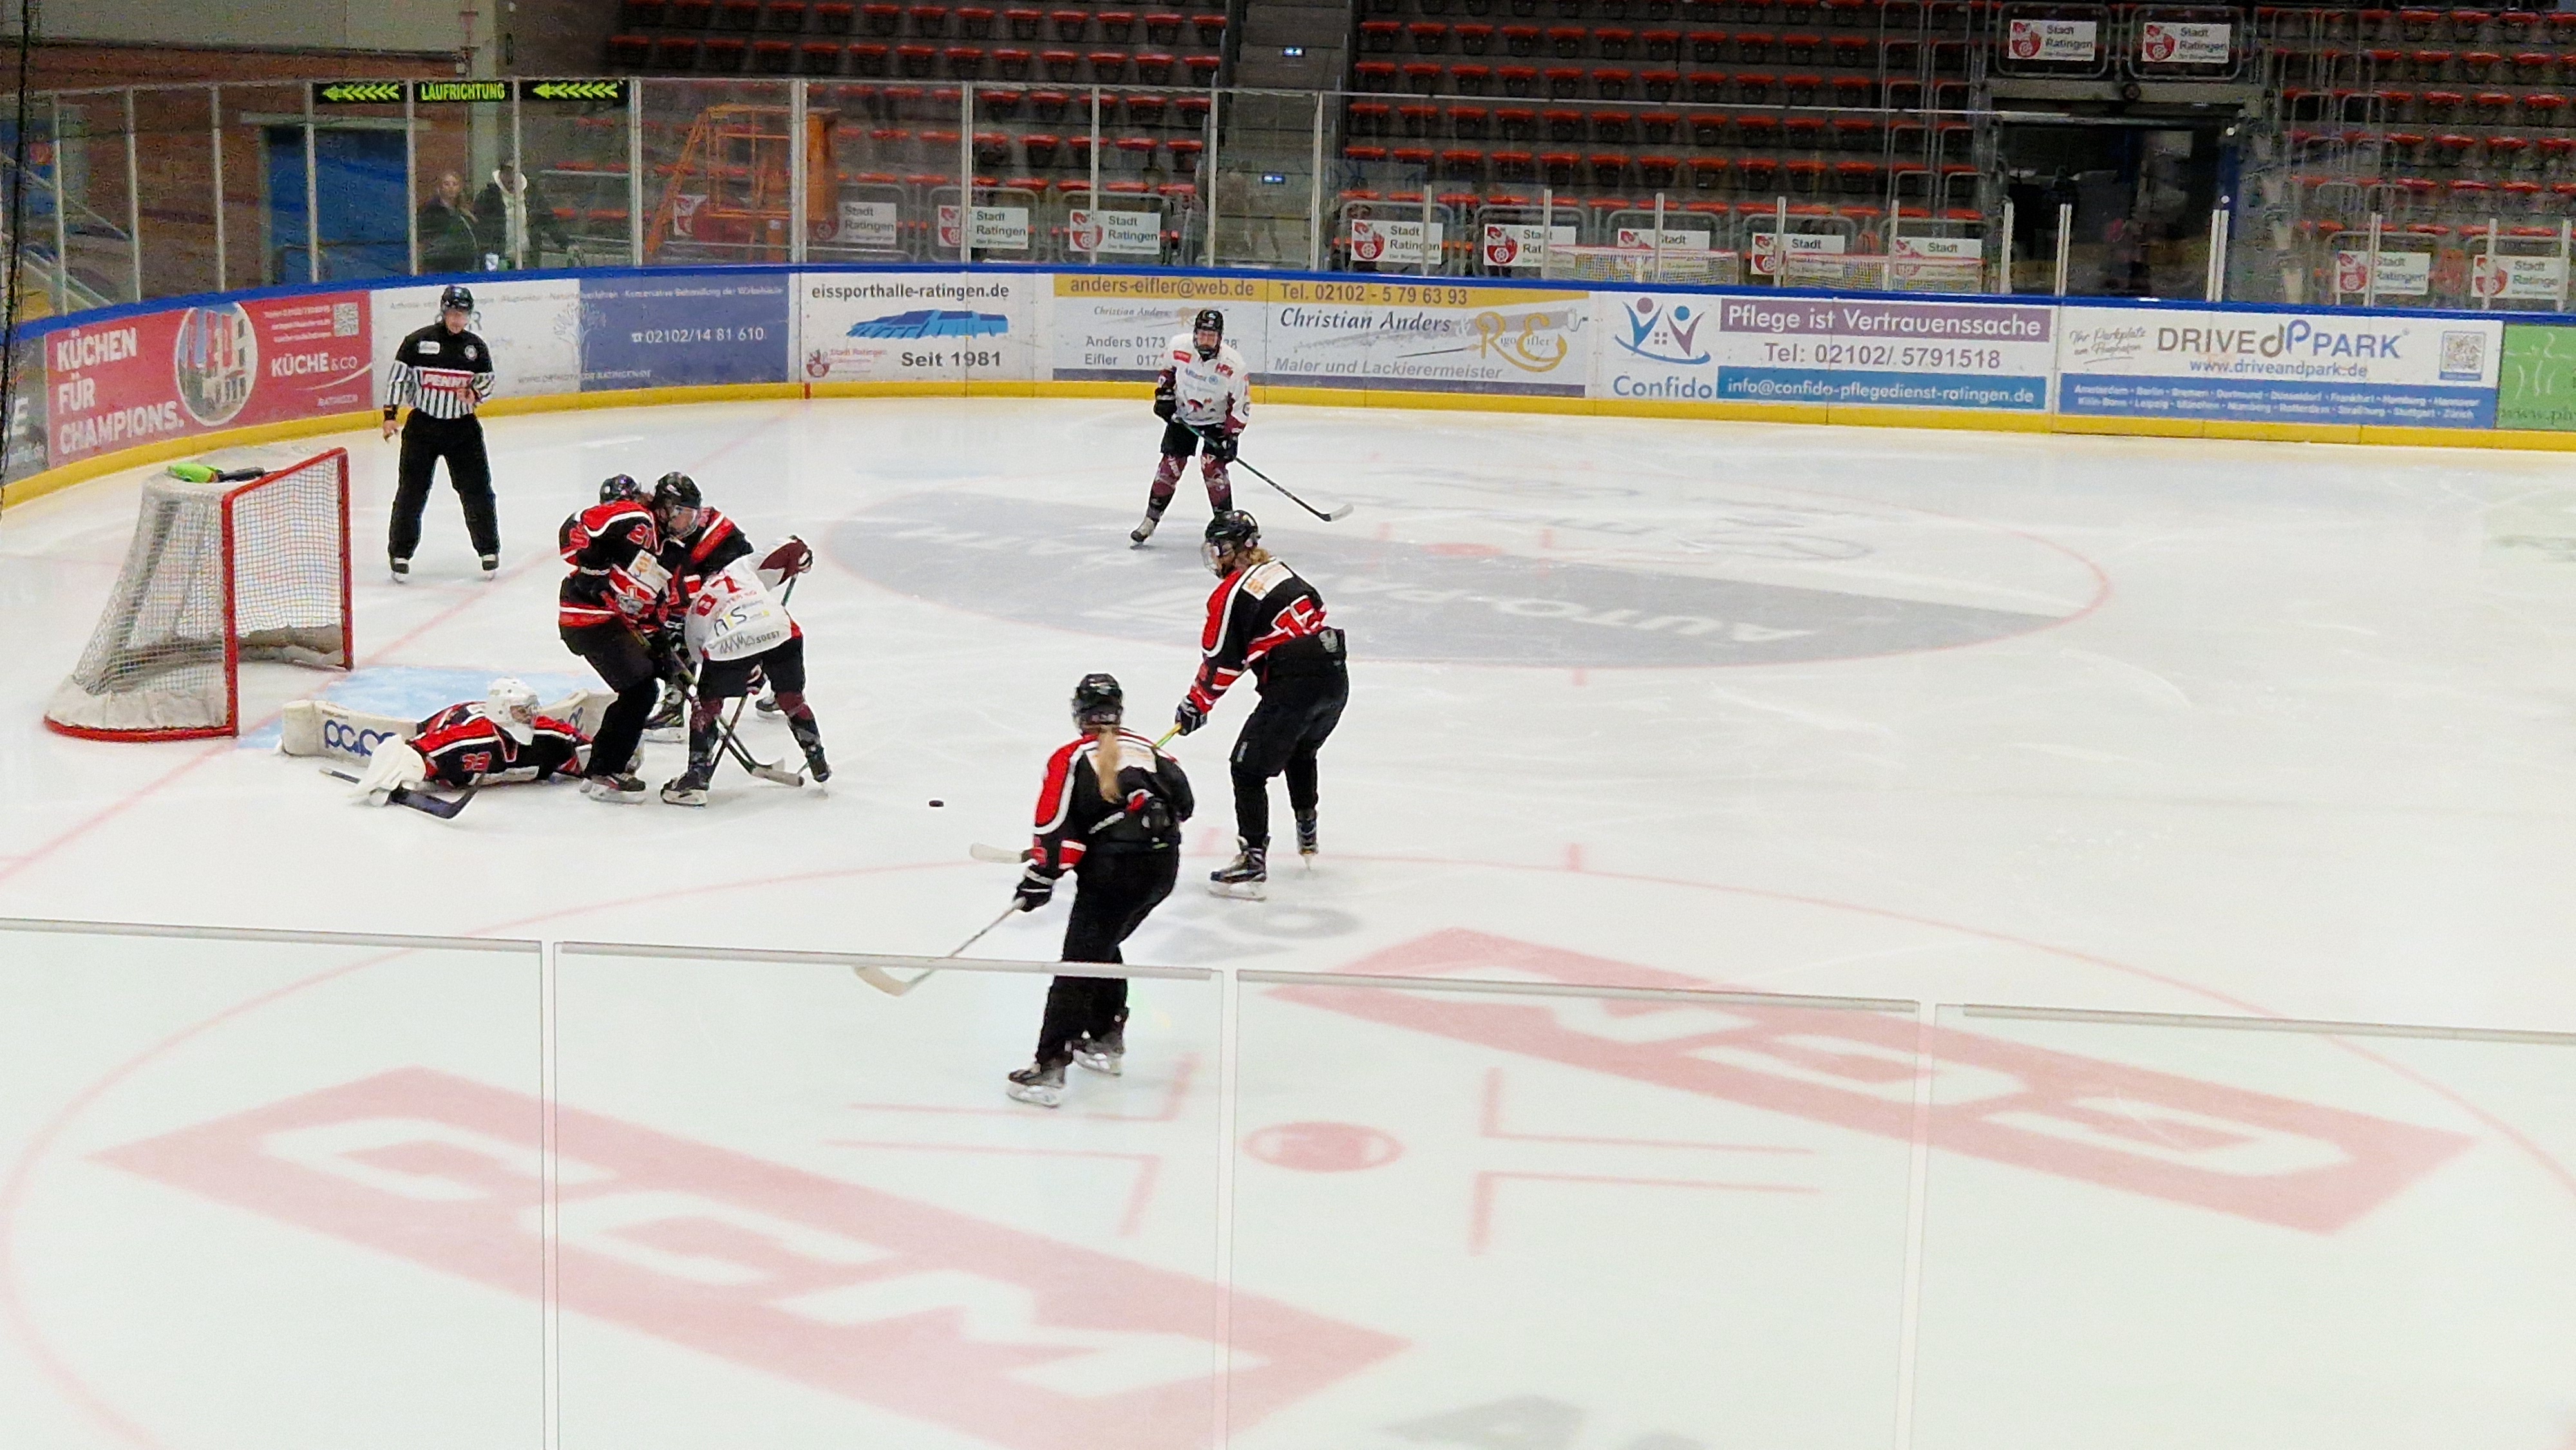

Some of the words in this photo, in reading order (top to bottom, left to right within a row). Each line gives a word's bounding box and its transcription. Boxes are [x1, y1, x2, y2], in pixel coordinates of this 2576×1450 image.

[421, 83, 506, 101] LAUFRICHTUNG
[844, 205, 874, 217] Stadt
[976, 211, 1005, 221] Stadt
[844, 220, 895, 233] Ratingen
[1108, 216, 1138, 227] Stadt
[1390, 225, 1420, 236] Stadt
[976, 225, 1026, 238] Ratingen
[1108, 230, 1158, 242] Ratingen
[1791, 239, 1822, 250] Stadt
[1928, 242, 1958, 253] Stadt
[2514, 261, 2546, 271] Stadt
[1070, 278, 1254, 297] anders-eifler@web.de
[2513, 276, 2559, 288] Ratinge
[811, 283, 1010, 301] eissporthalle-ratingen.de
[1280, 283, 1309, 301] Tel.
[1315, 284, 1365, 301] 02102
[1383, 287, 1392, 302] 5
[1398, 287, 1417, 303] 79
[1423, 288, 1442, 305] 63
[1449, 289, 1468, 305] 93
[1280, 307, 1373, 329] Christian
[1379, 311, 1452, 332] Anders
[1728, 306, 1800, 330] Pflege
[1809, 310, 1834, 329] ist
[1844, 309, 2041, 336] Vertrauenssache
[646, 329, 710, 343] 02102/14
[717, 328, 732, 341] 81
[738, 327, 764, 341] 610
[1086, 336, 1132, 348] Anders
[1136, 336, 1166, 349] 0173
[2157, 326, 2257, 354] DRIVE
[2313, 332, 2402, 359] PARK
[57, 327, 138, 372] KÜCHEN
[1764, 342, 1806, 364] Tel:
[1902, 348, 2001, 369] 5791518
[271, 352, 330, 377] KÜCHE
[901, 350, 943, 368] Seit
[952, 350, 1001, 367] 1981
[1085, 353, 1118, 366] Eifler
[1137, 355, 1161, 367] 017
[1274, 357, 1321, 372] Maler
[1325, 360, 1358, 374] und
[1362, 361, 1502, 379] Lackierermeister
[2190, 359, 2368, 379] www.driveandpark.de
[58, 371, 96, 415] FÜR
[1613, 375, 1713, 400] Confido
[1728, 377, 2034, 406] info@confido-pflegedienst-ratingen.de
[59, 400, 185, 454] CHAMPIONS.
[1333, 575, 1817, 643] AUTO-PA
